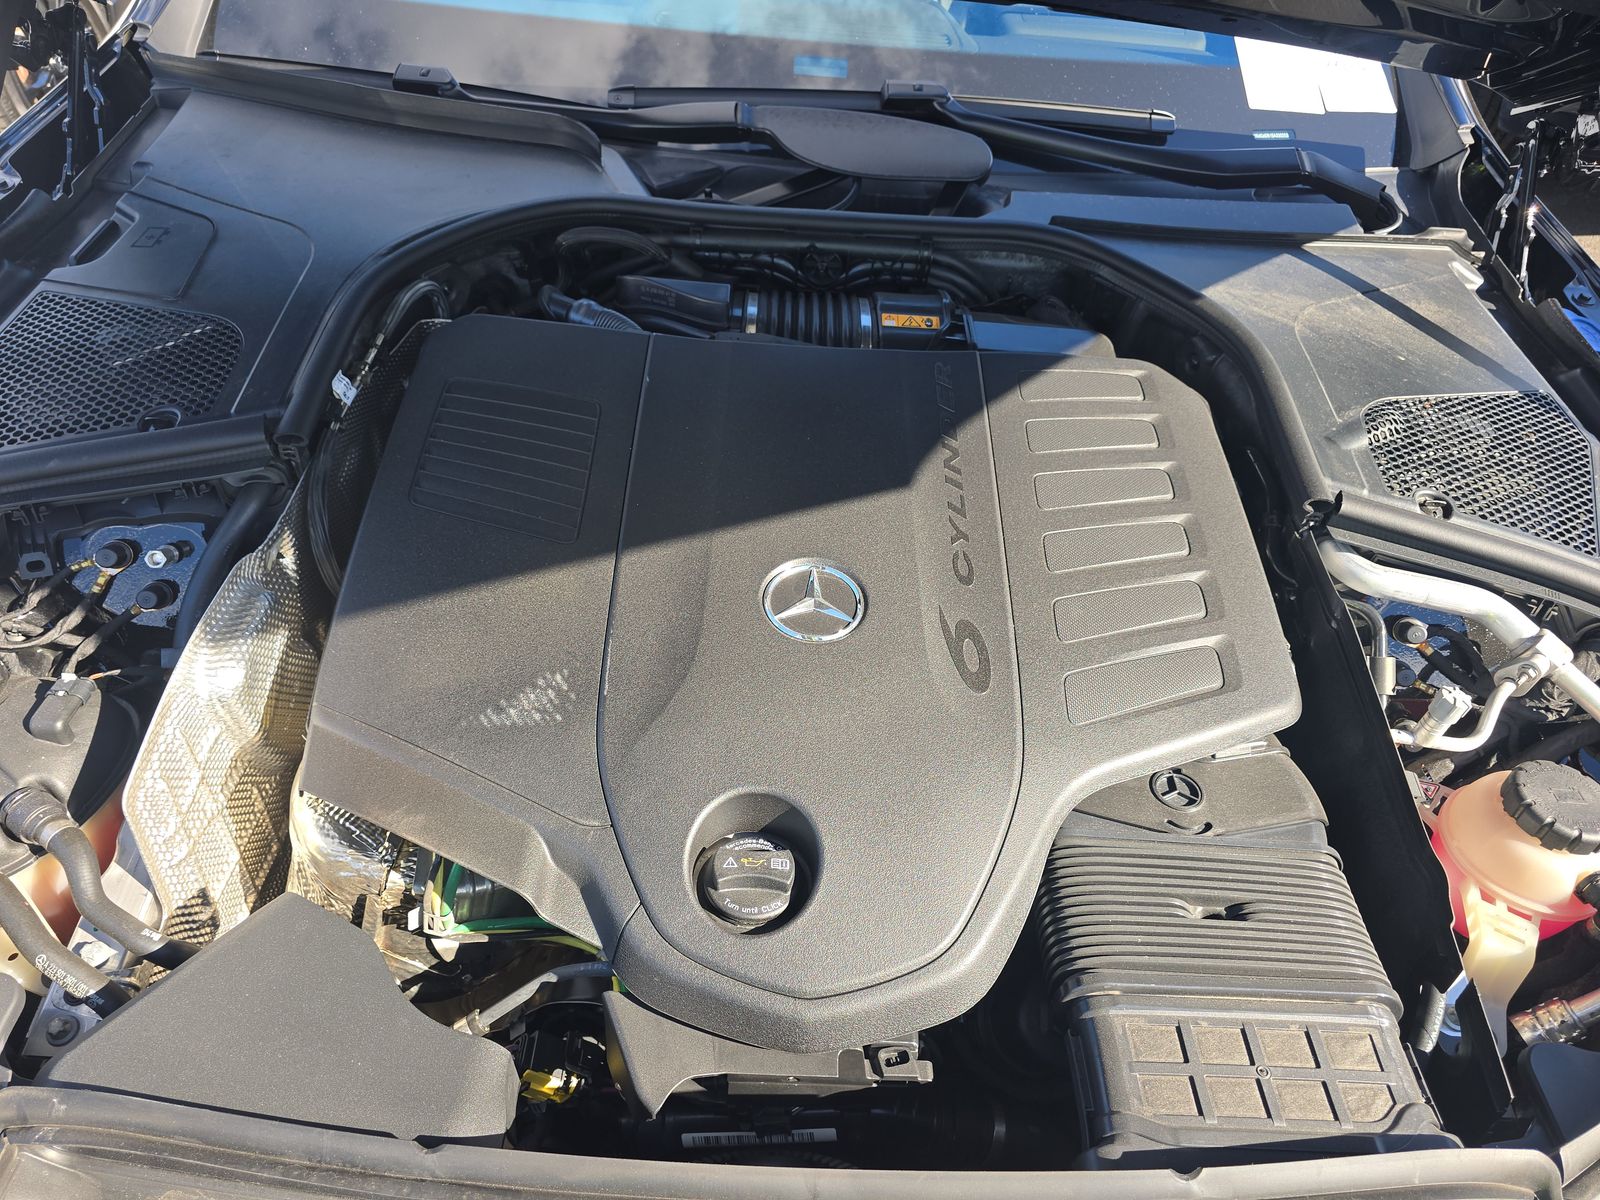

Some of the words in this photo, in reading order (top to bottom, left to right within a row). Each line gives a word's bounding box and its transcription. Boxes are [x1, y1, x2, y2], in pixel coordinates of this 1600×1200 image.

[935, 360, 975, 588] CYLINDER
[938, 604, 992, 695] 6
[723, 897, 740, 912] Turn
[741, 906, 758, 914] until
[761, 899, 784, 914] CLICK
